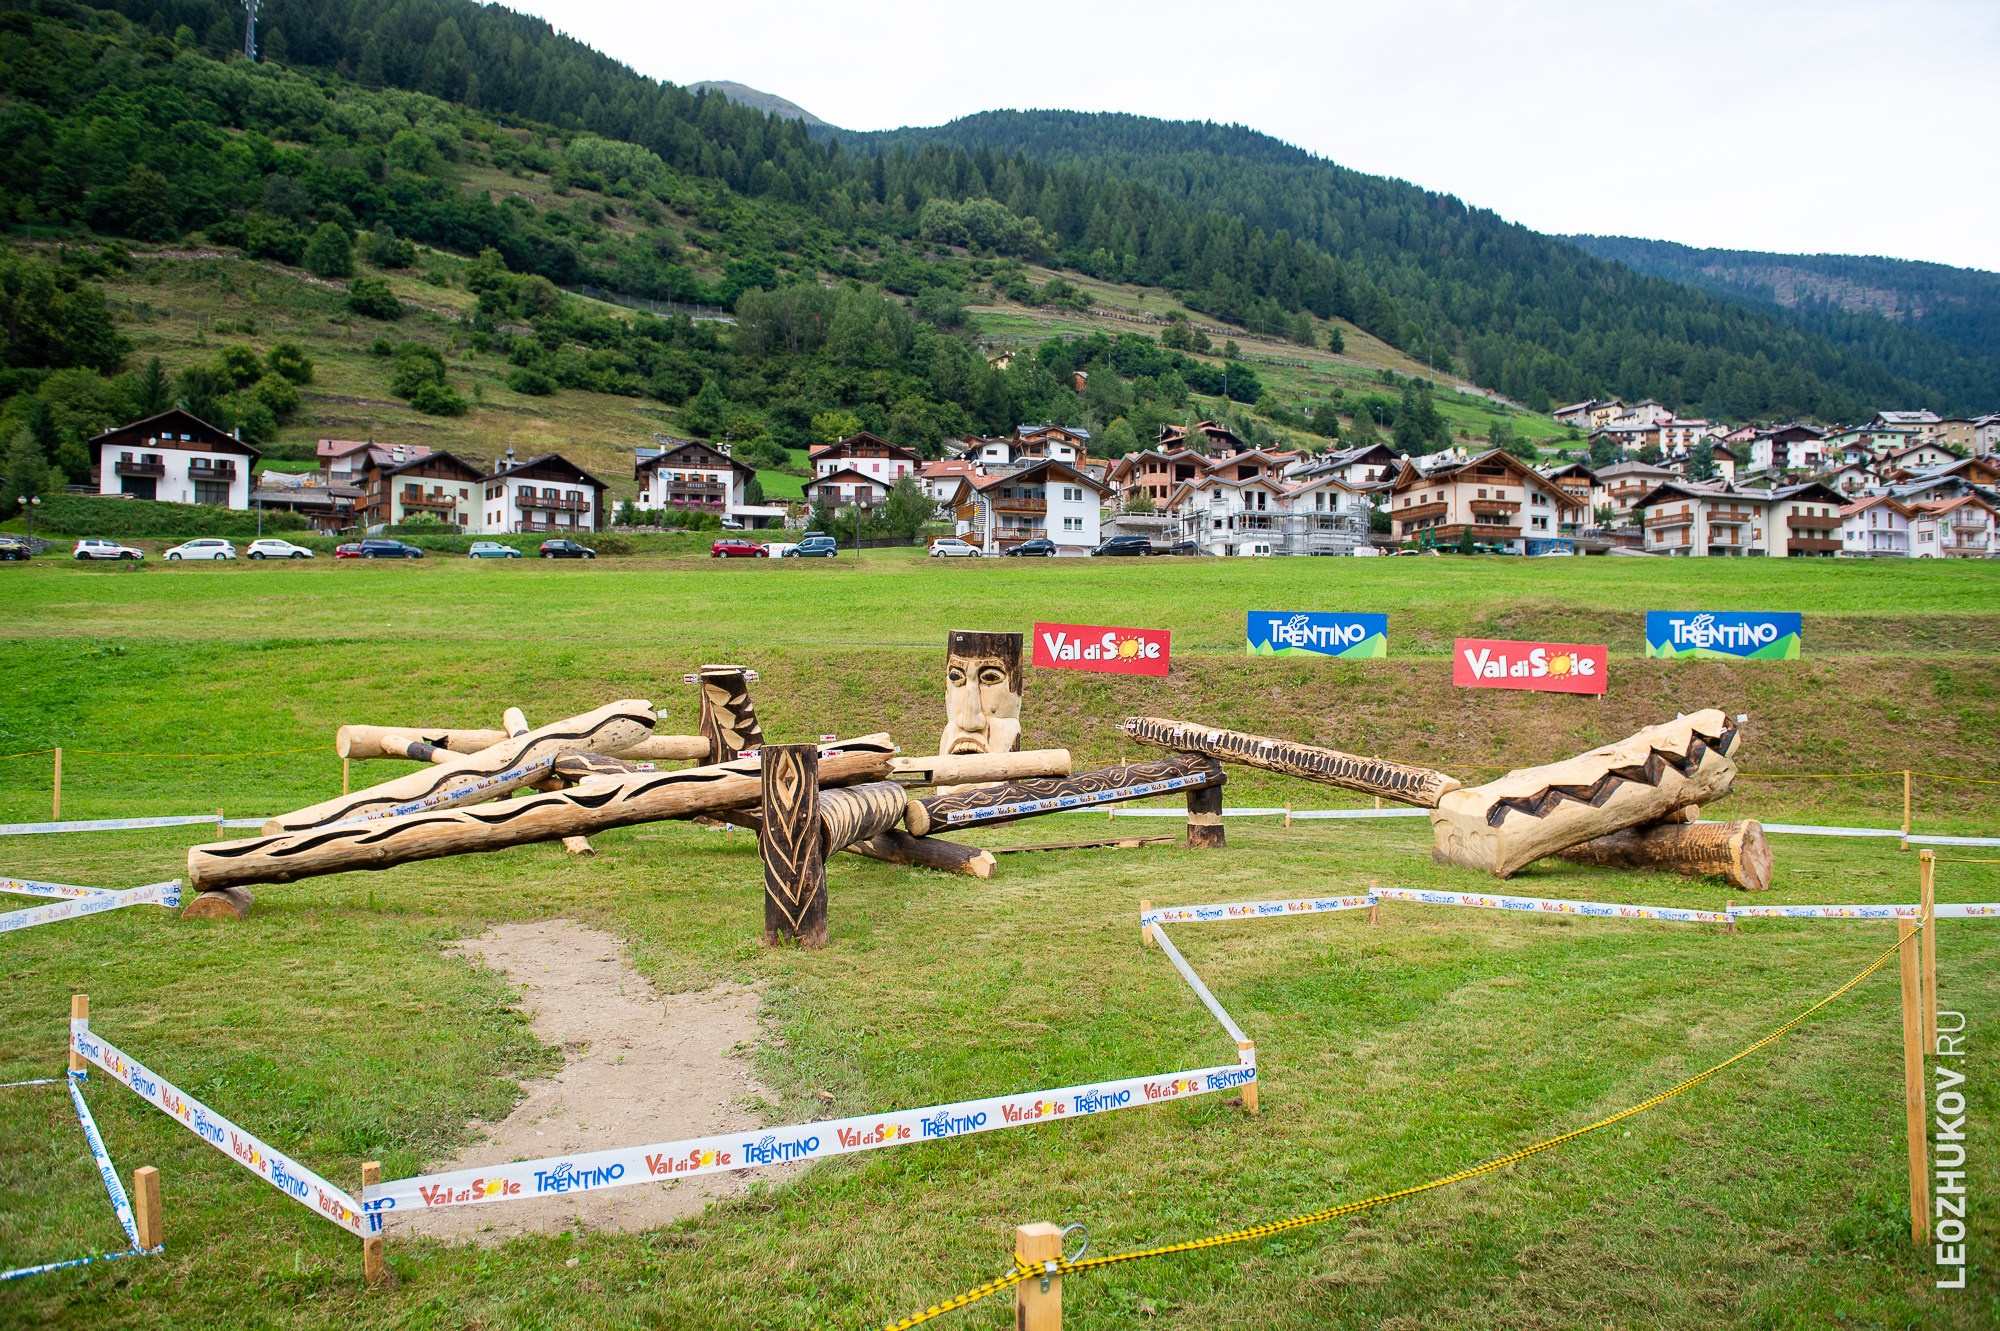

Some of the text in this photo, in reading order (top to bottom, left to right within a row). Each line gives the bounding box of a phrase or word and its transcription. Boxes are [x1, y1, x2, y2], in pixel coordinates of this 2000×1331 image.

[1042, 632, 1160, 662] Val di Sole
[1268, 618, 1366, 648] TRENTINO
[1668, 618, 1778, 648] TRENTINO
[1464, 648, 1596, 680] Val di Sole
[420, 1067, 1256, 1208] Val di Sole TRENTINO Val di Sole TRENTINO Val di Sole TRENTINO Val di Sole TRENTINO Val di Sole TRENTINO
